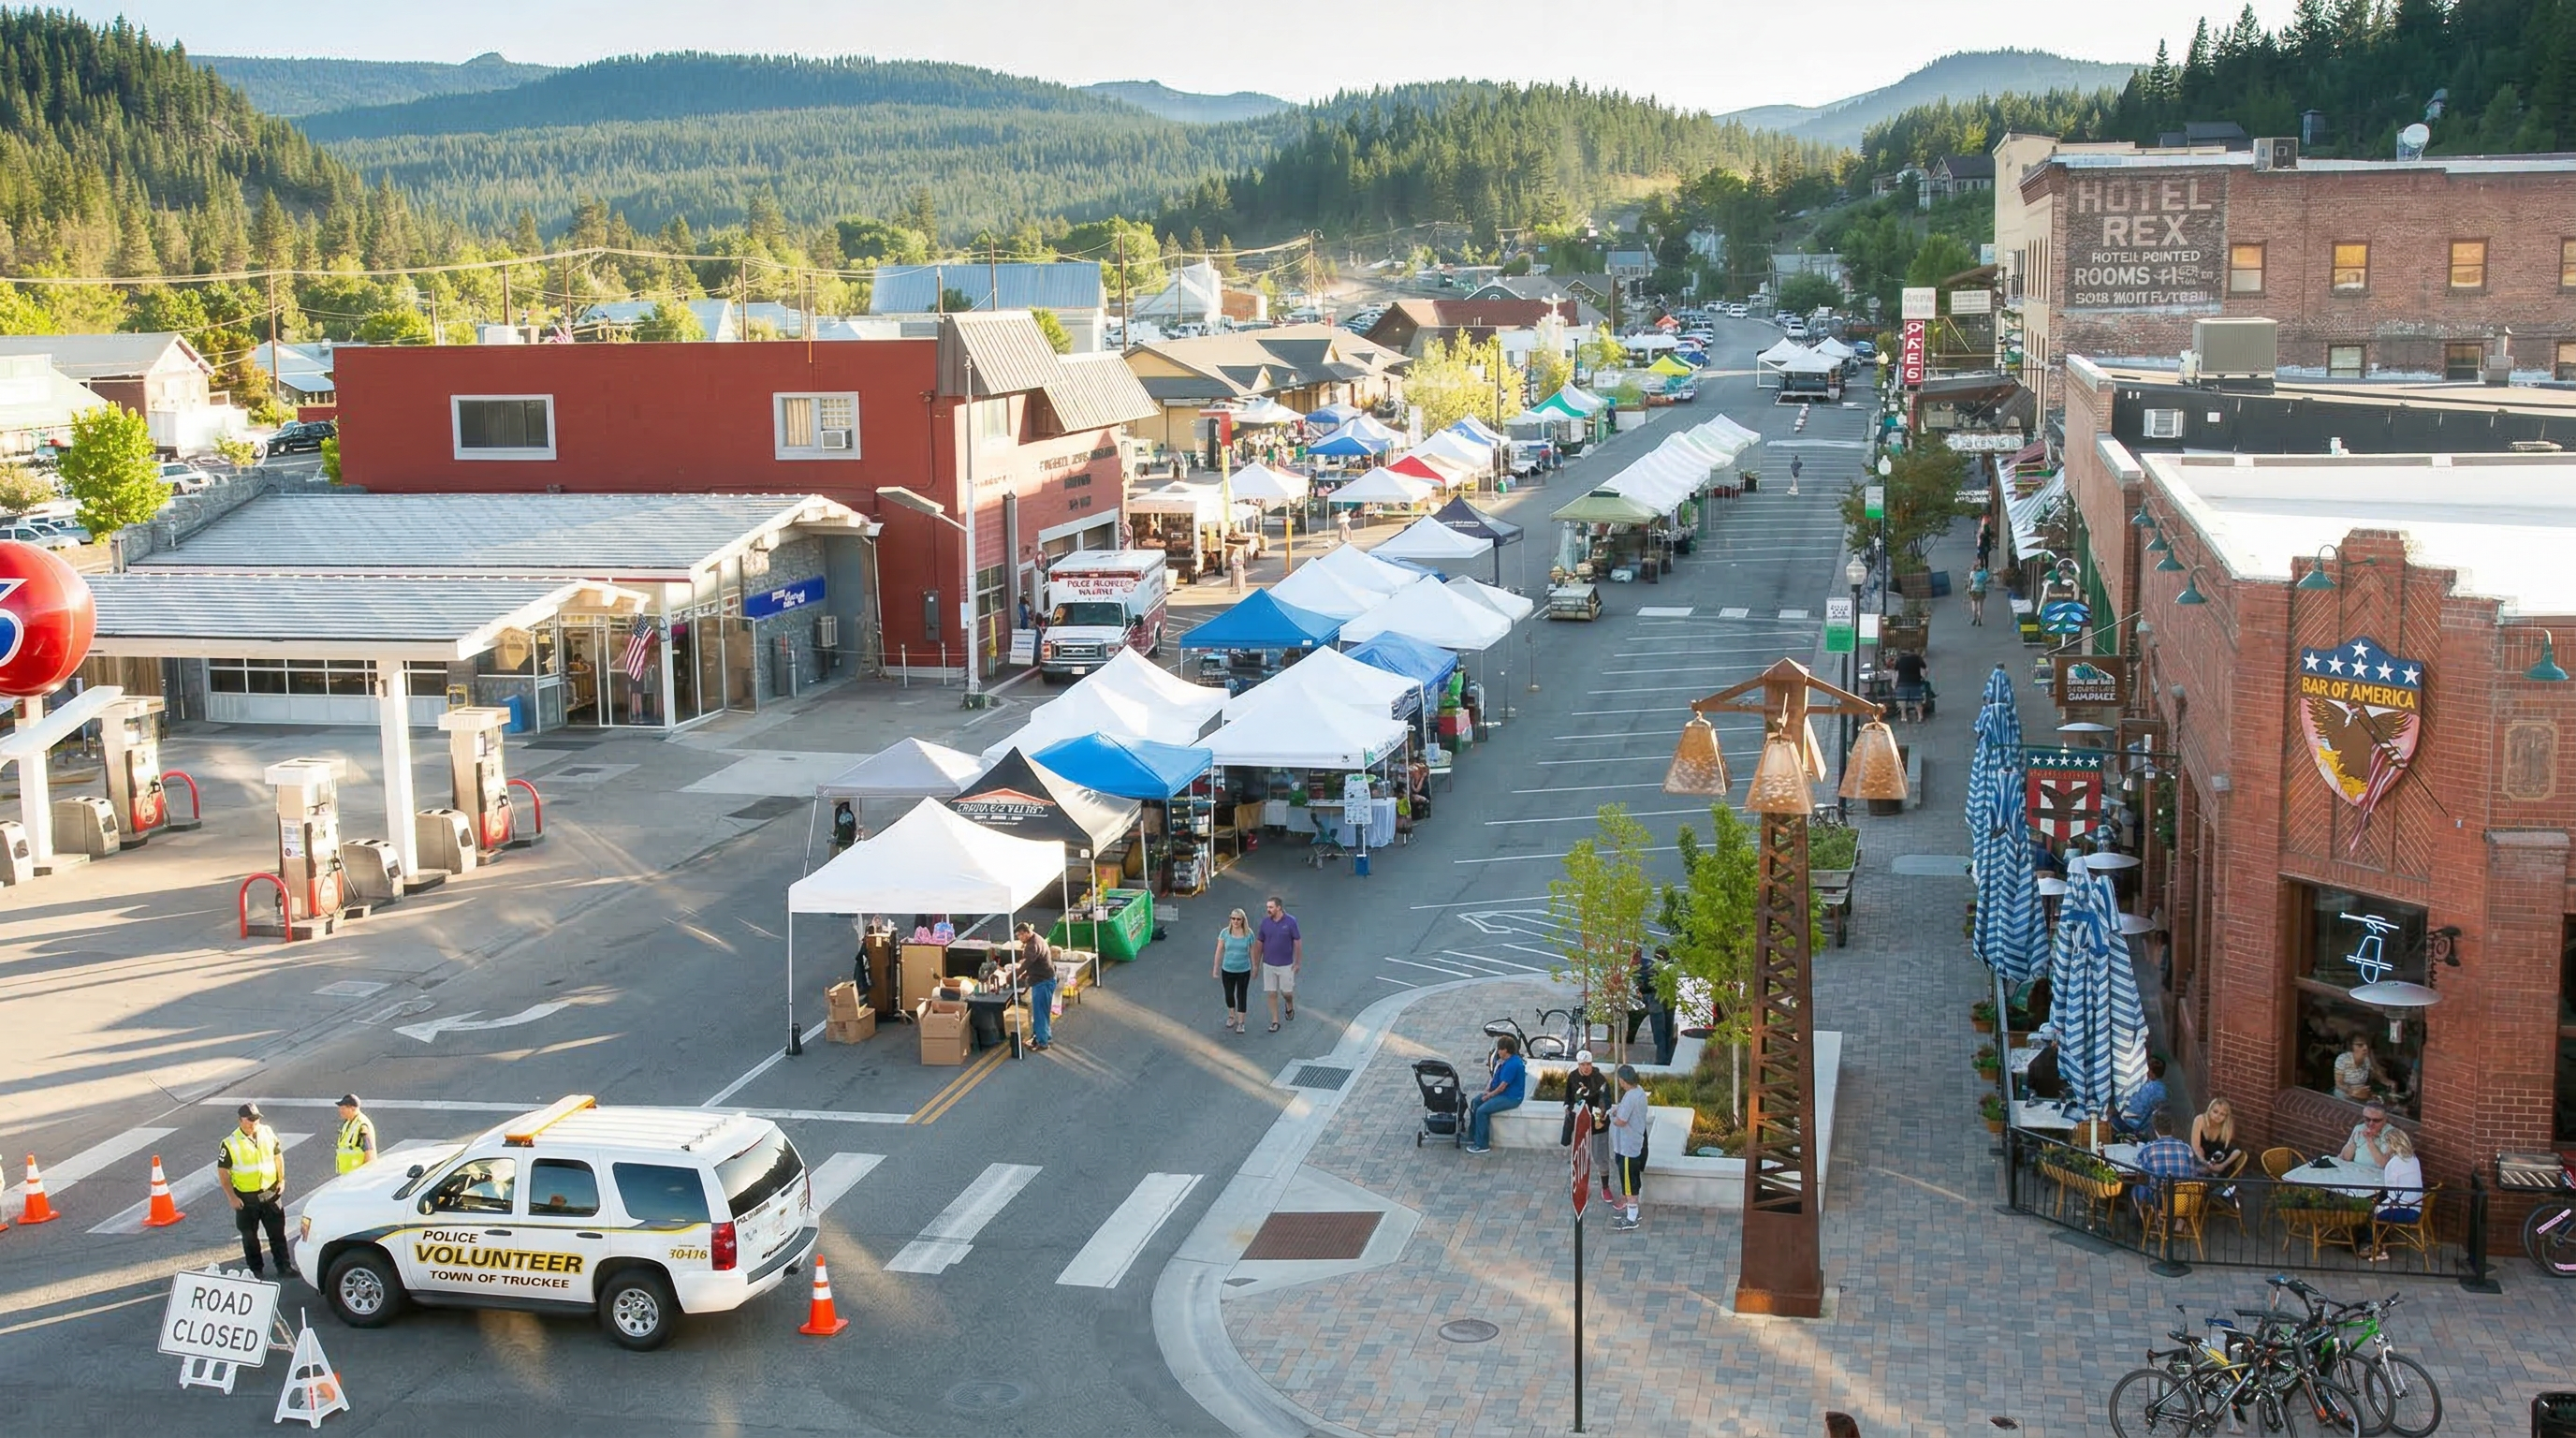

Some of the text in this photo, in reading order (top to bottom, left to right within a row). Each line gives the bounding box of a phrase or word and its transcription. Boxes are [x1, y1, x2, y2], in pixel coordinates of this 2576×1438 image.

[2078, 178, 2212, 213] HOTEL
[2102, 214, 2189, 246] REX
[2074, 266, 2150, 286] ROOMS
[2303, 676, 2415, 709] BAR OF AMERICA
[423, 1229, 478, 1244] POLICE
[415, 1243, 584, 1274] VOLUNTEER
[429, 1270, 570, 1289] TOWN OF TRUCKEE
[191, 1286, 253, 1315] ROAD
[173, 1318, 258, 1352] CLOSED
